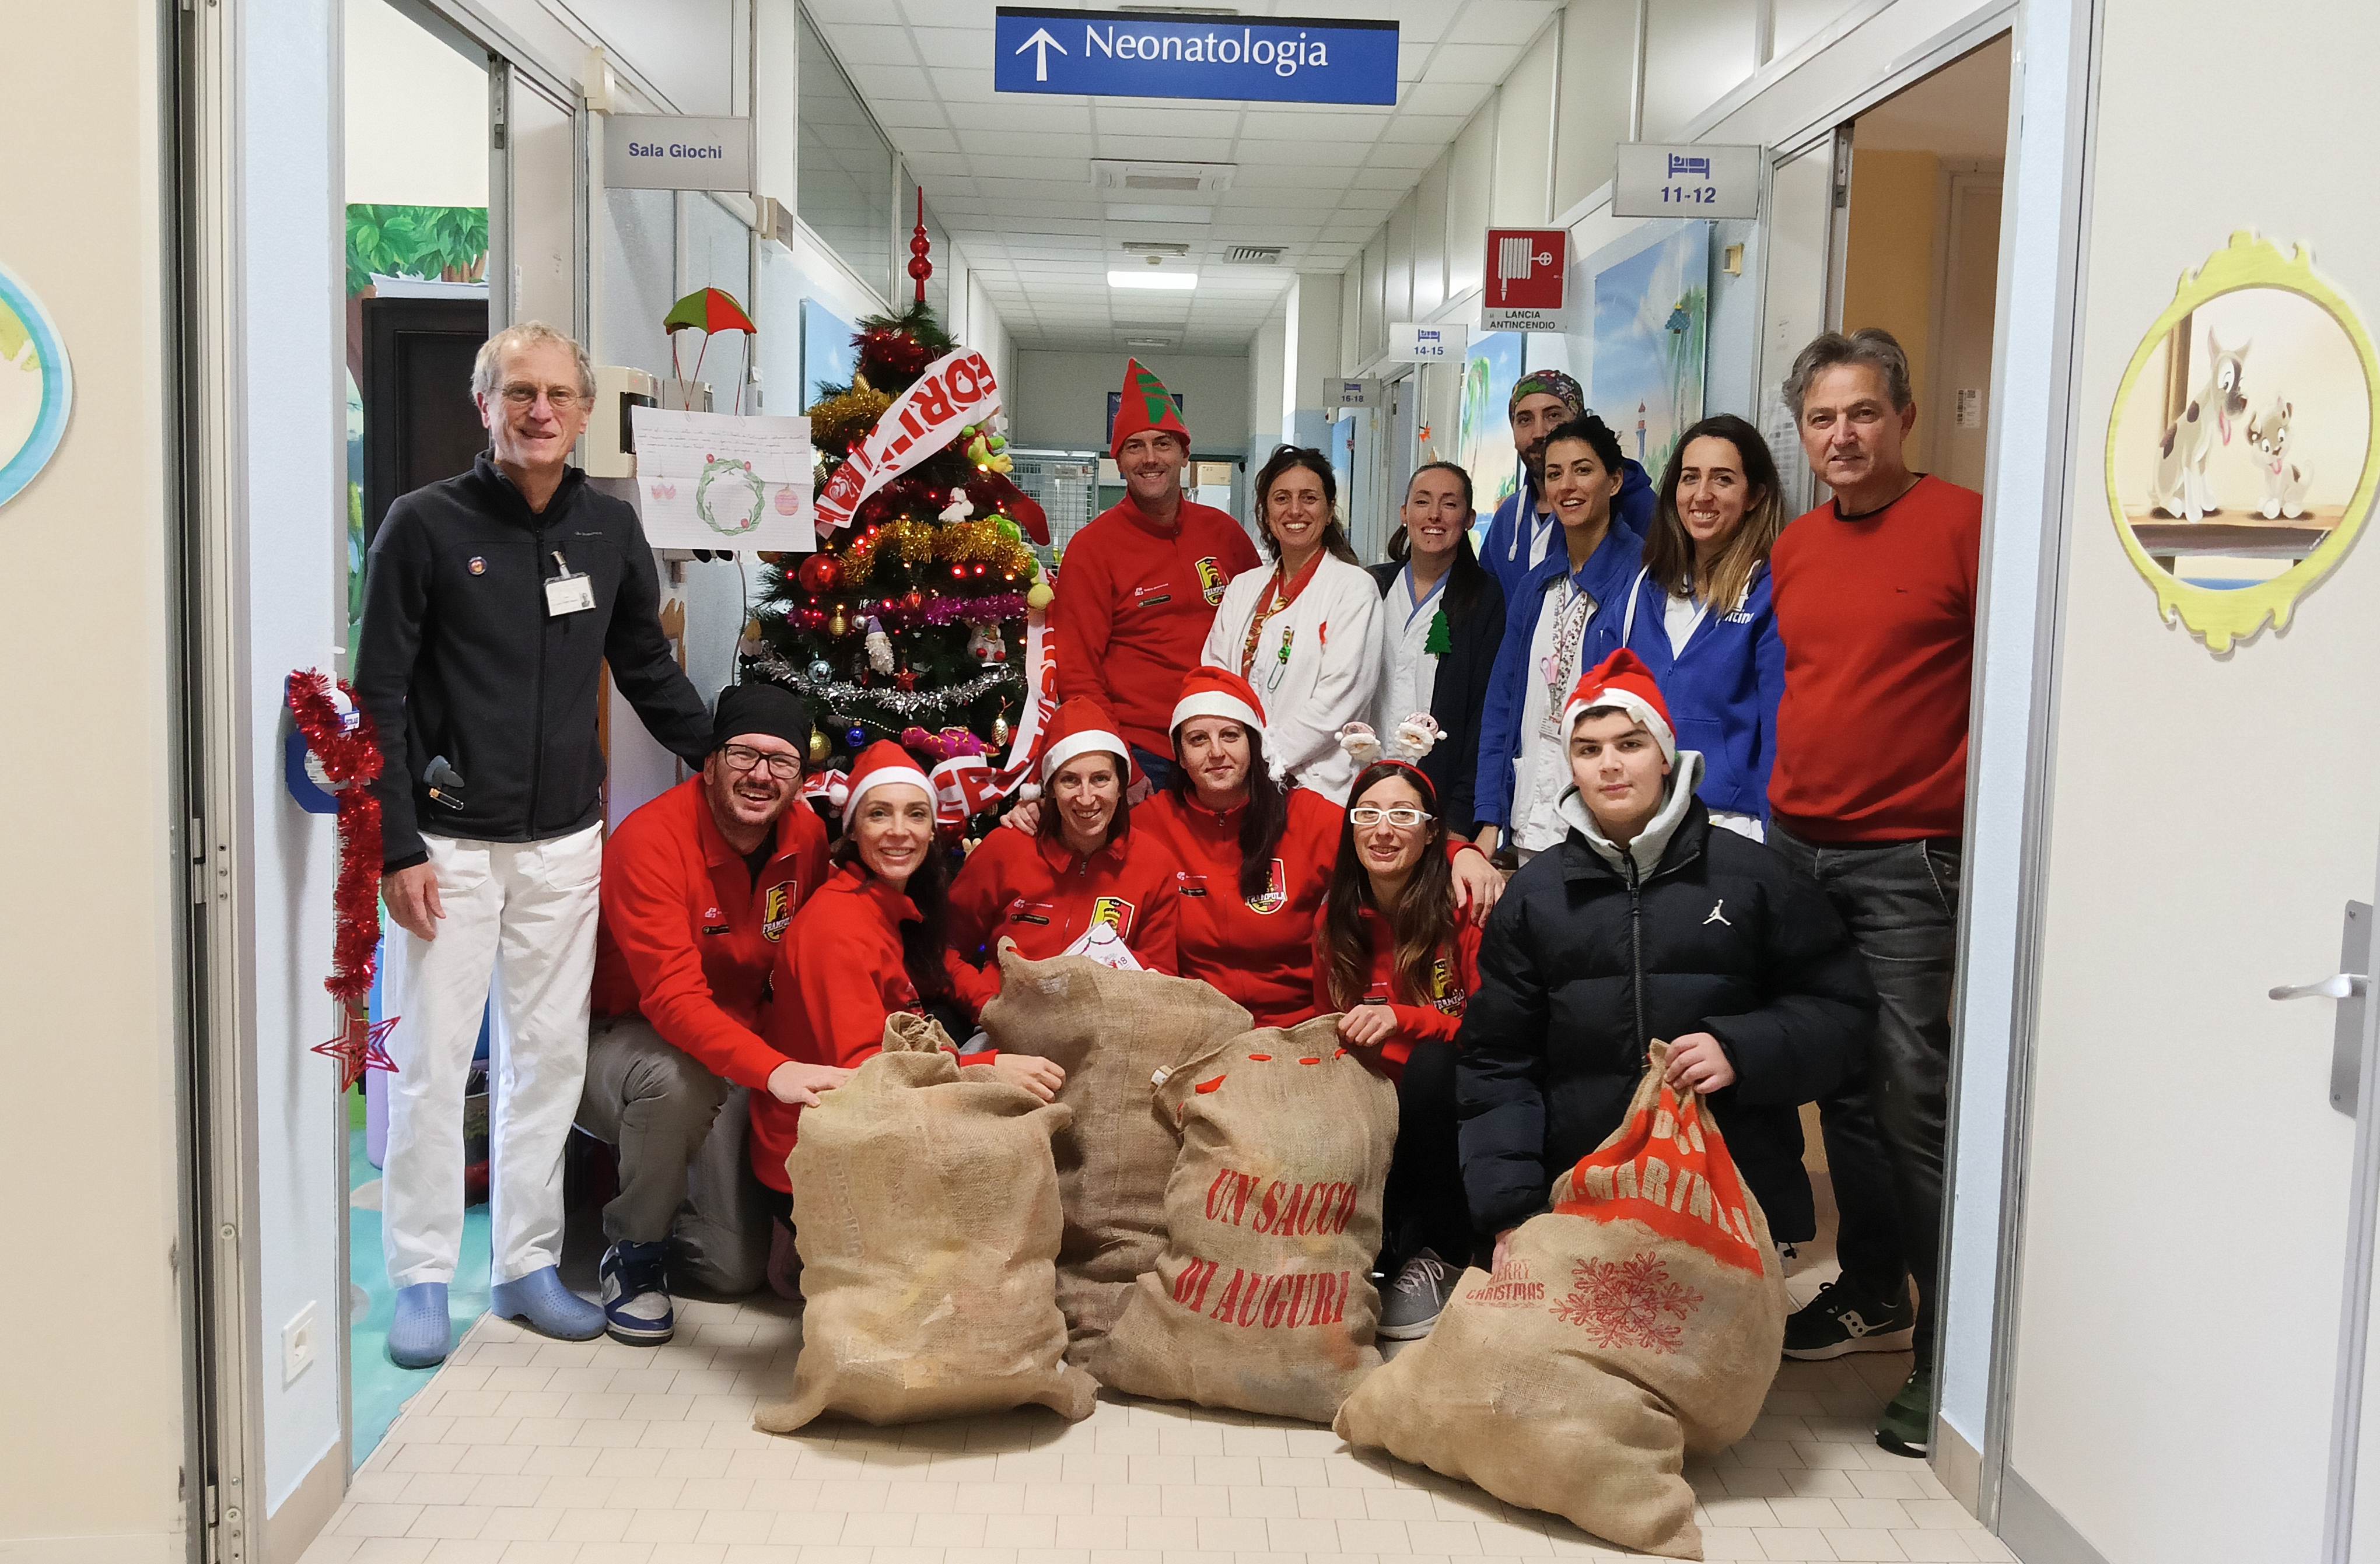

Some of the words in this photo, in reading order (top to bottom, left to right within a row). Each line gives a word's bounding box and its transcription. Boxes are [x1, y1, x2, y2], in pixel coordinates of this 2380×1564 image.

[1086, 24, 1329, 77] Neonatologia
[629, 142, 664, 157] Sala
[669, 143, 722, 159] Giochi
[1661, 187, 1716, 203] 11-12
[1505, 310, 1541, 318] LANCIA
[1490, 321, 1556, 329] ANTINCENDIO
[1414, 346, 1444, 355] 14-15
[1118, 956, 1128, 966] 18
[1205, 1168, 1261, 1226] UN
[1252, 1180, 1357, 1236] SACCO
[1172, 1256, 1219, 1313] DI
[1209, 1268, 1350, 1329] AUGURI
[1465, 1282, 1545, 1301] CHRISTMAS
